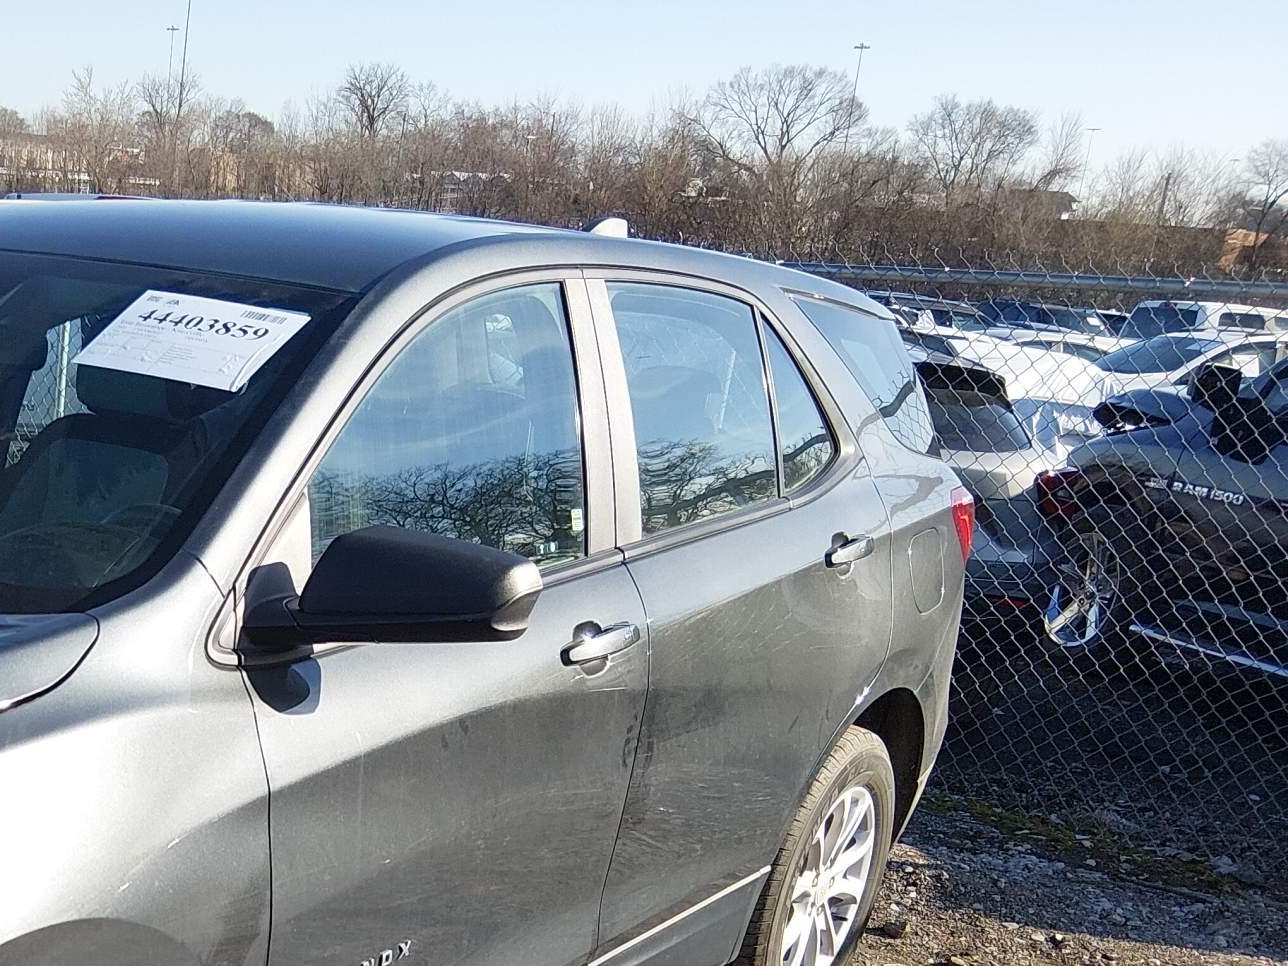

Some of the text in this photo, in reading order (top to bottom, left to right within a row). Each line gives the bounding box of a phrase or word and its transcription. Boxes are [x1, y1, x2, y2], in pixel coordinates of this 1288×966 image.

[138, 309, 269, 341] 44403859
[1172, 481, 1244, 506] RAM 1500
